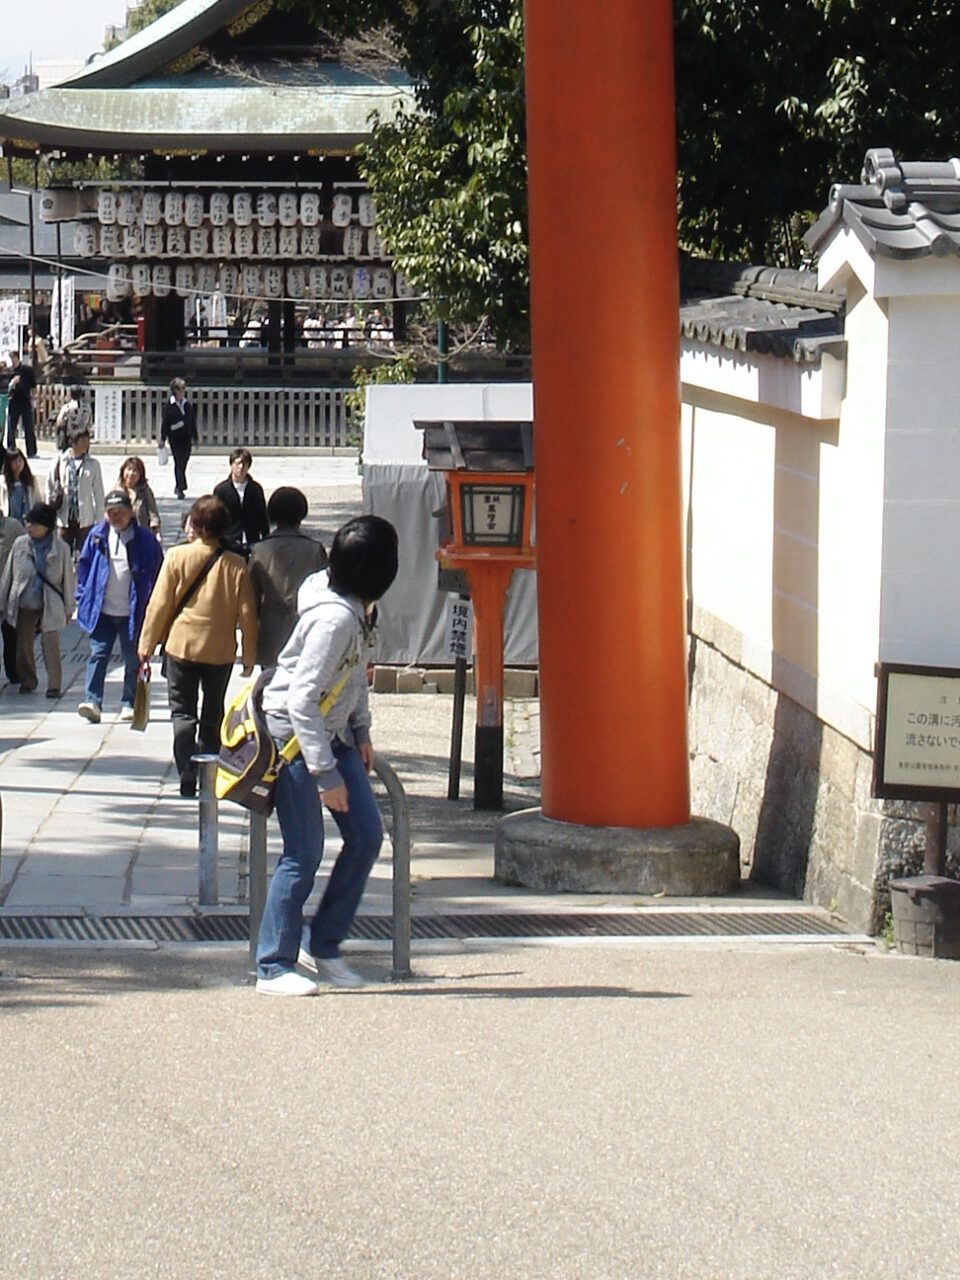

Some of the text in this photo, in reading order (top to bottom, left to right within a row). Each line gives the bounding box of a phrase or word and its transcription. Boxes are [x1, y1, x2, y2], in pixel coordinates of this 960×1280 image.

[449, 604, 469, 657] 境内禁煙
[905, 733, 960, 748] 流さないで
